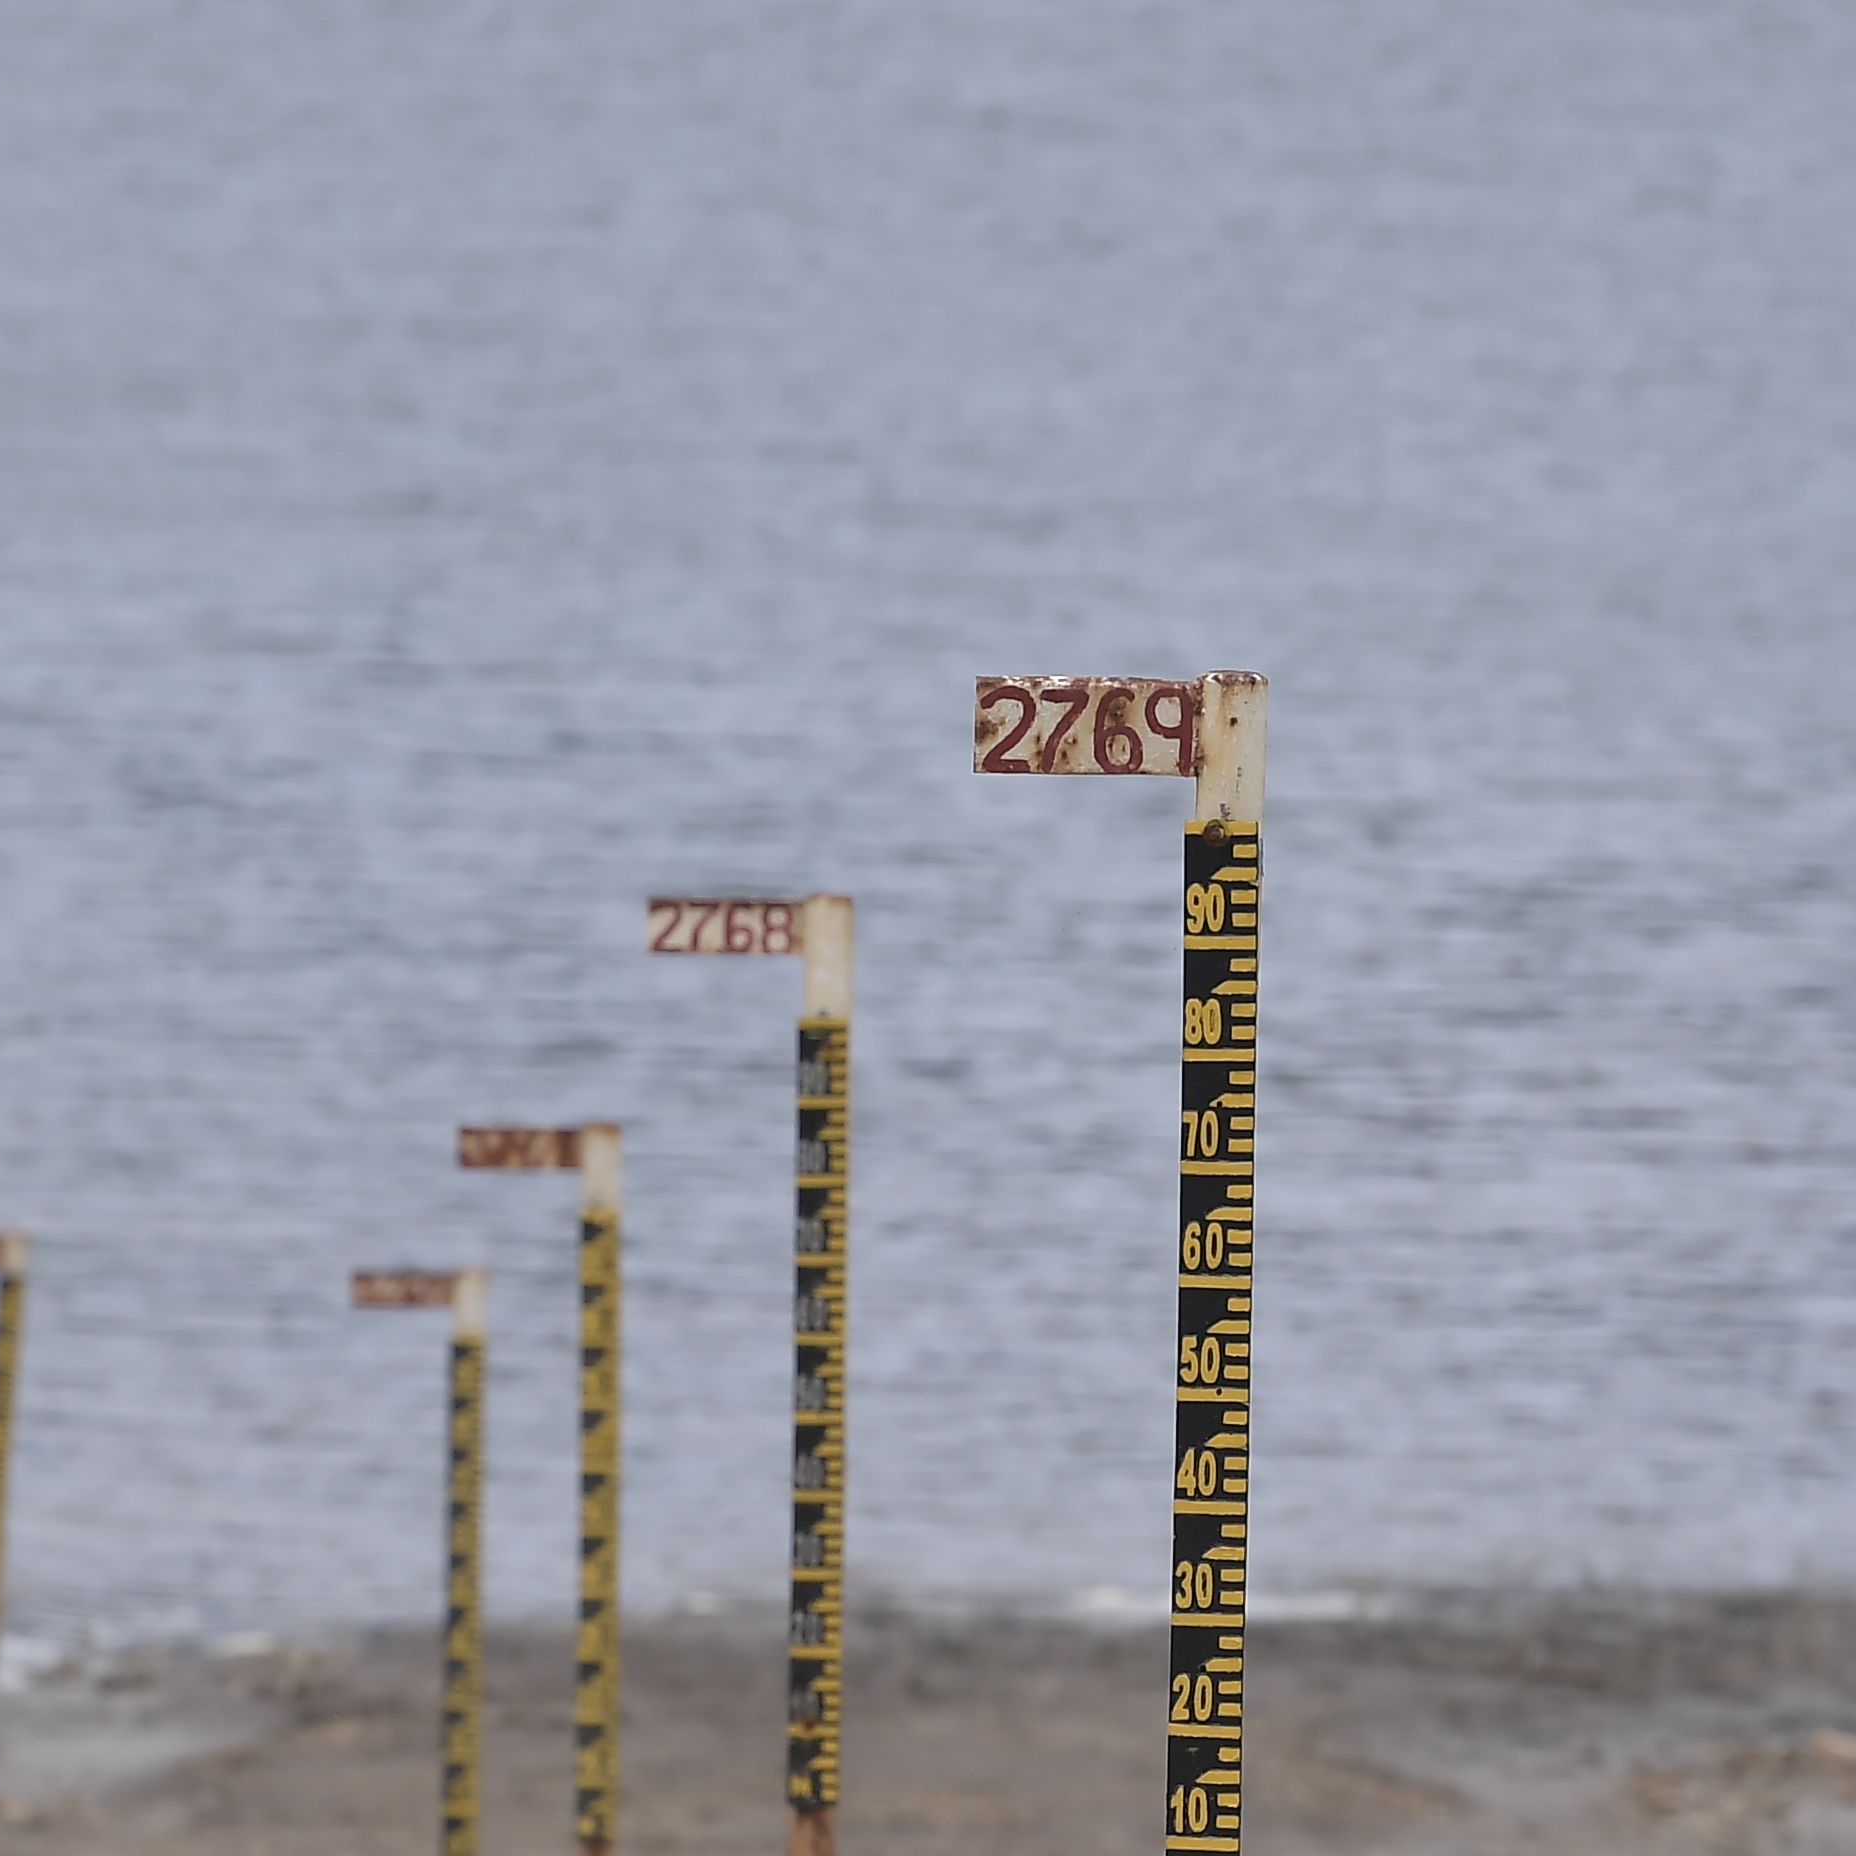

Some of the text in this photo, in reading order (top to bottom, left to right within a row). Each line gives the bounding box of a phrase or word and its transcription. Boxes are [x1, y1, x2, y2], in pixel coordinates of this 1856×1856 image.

[979, 685, 1194, 776] 2769
[650, 901, 793, 953] 2768
[1186, 883, 1225, 934] 90
[1184, 998, 1222, 1045] 80
[1182, 1111, 1219, 1157] 70
[1182, 1221, 1224, 1270] 60
[1180, 1336, 1220, 1383] 50
[1177, 1448, 1217, 1497] 40
[1174, 1563, 1213, 1609] 30
[1172, 1673, 1213, 1722] 20
[1170, 1787, 1208, 1834] 10
